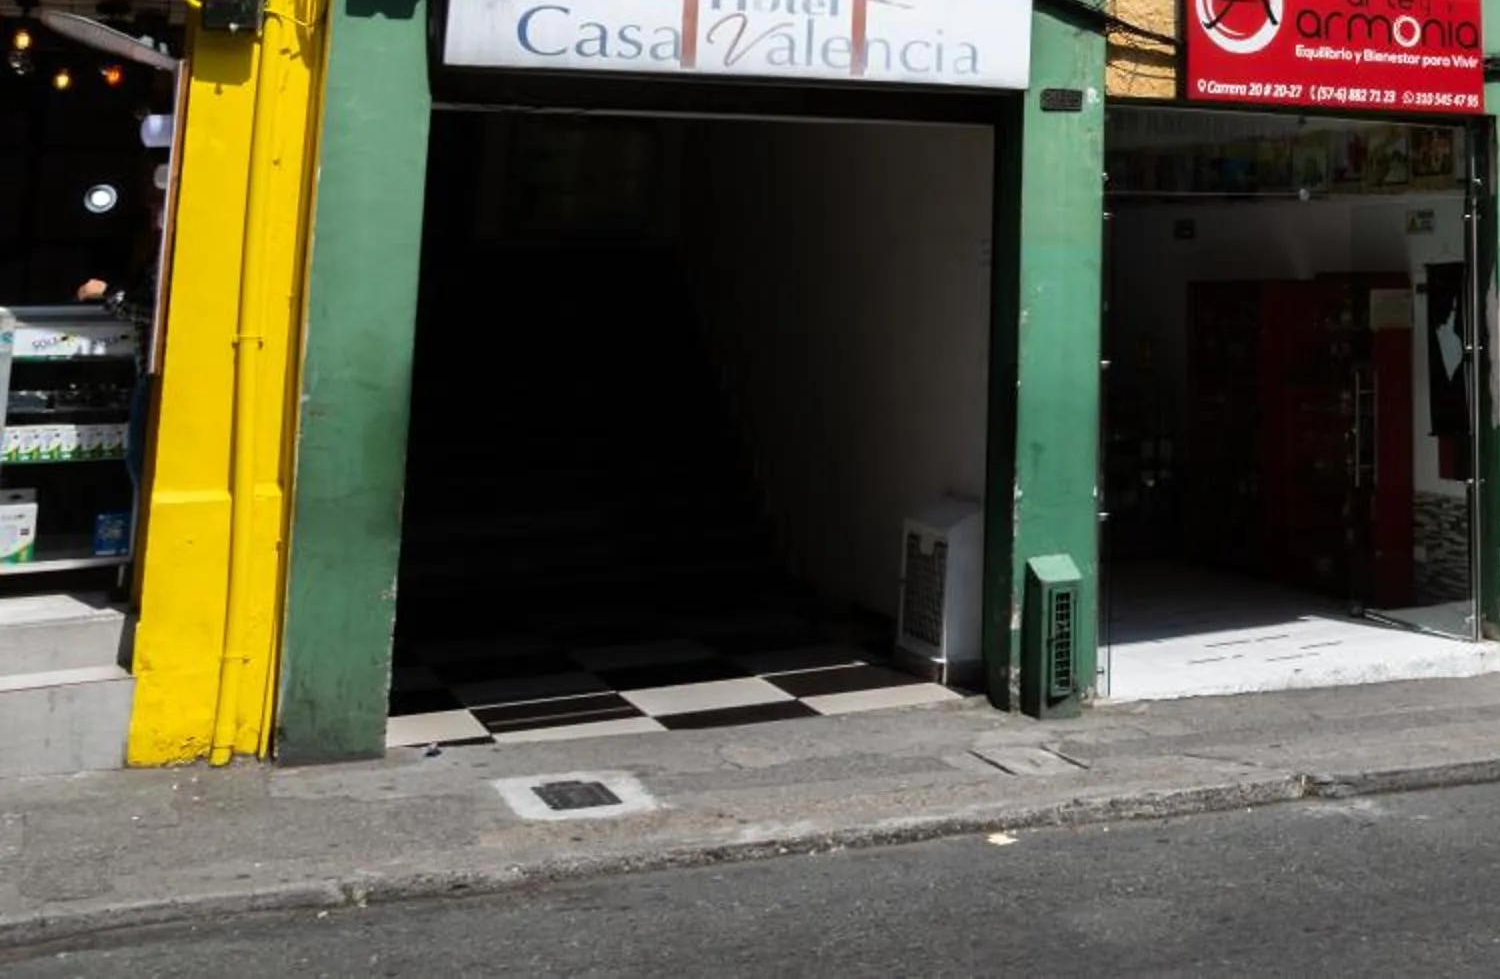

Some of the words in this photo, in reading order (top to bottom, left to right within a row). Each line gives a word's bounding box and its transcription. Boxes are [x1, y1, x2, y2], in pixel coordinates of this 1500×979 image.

[517, 4, 683, 62] Casa
[706, 11, 980, 75] Valencia
[1363, 48, 1420, 65] Bienestar
[1421, 55, 1451, 68] para
